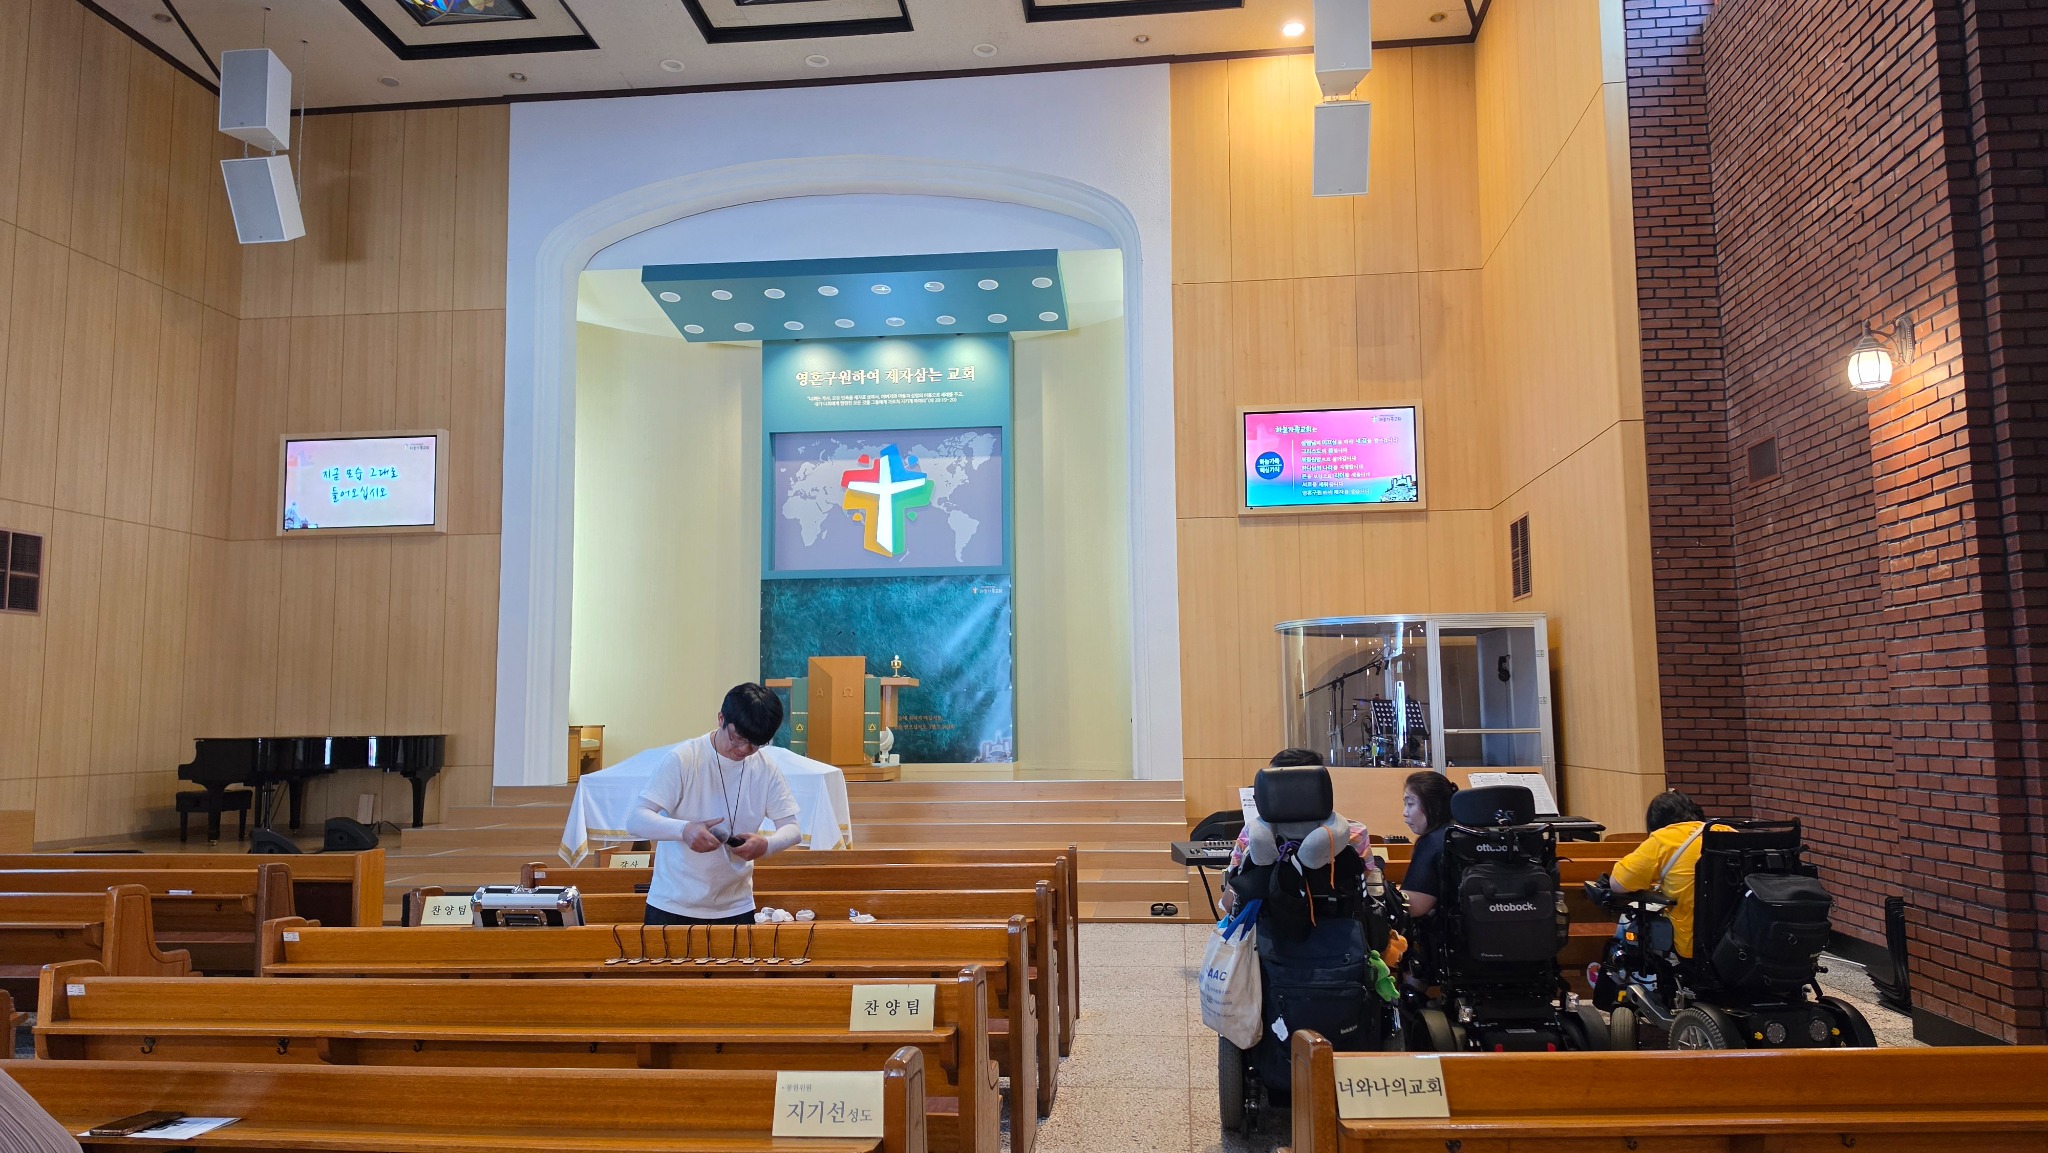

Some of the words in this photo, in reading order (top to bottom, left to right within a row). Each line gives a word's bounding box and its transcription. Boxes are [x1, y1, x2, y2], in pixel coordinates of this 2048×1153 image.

[796, 368, 880, 387] 영혼구원하여
[884, 367, 943, 384] 제자삼는
[947, 366, 975, 382] 교회
[323, 468, 340, 481] 지금
[346, 467, 363, 481] 모습
[370, 467, 399, 478] 그대로
[332, 486, 388, 503] 들어오십시오
[1338, 1077, 1443, 1097] 너와나의교회
